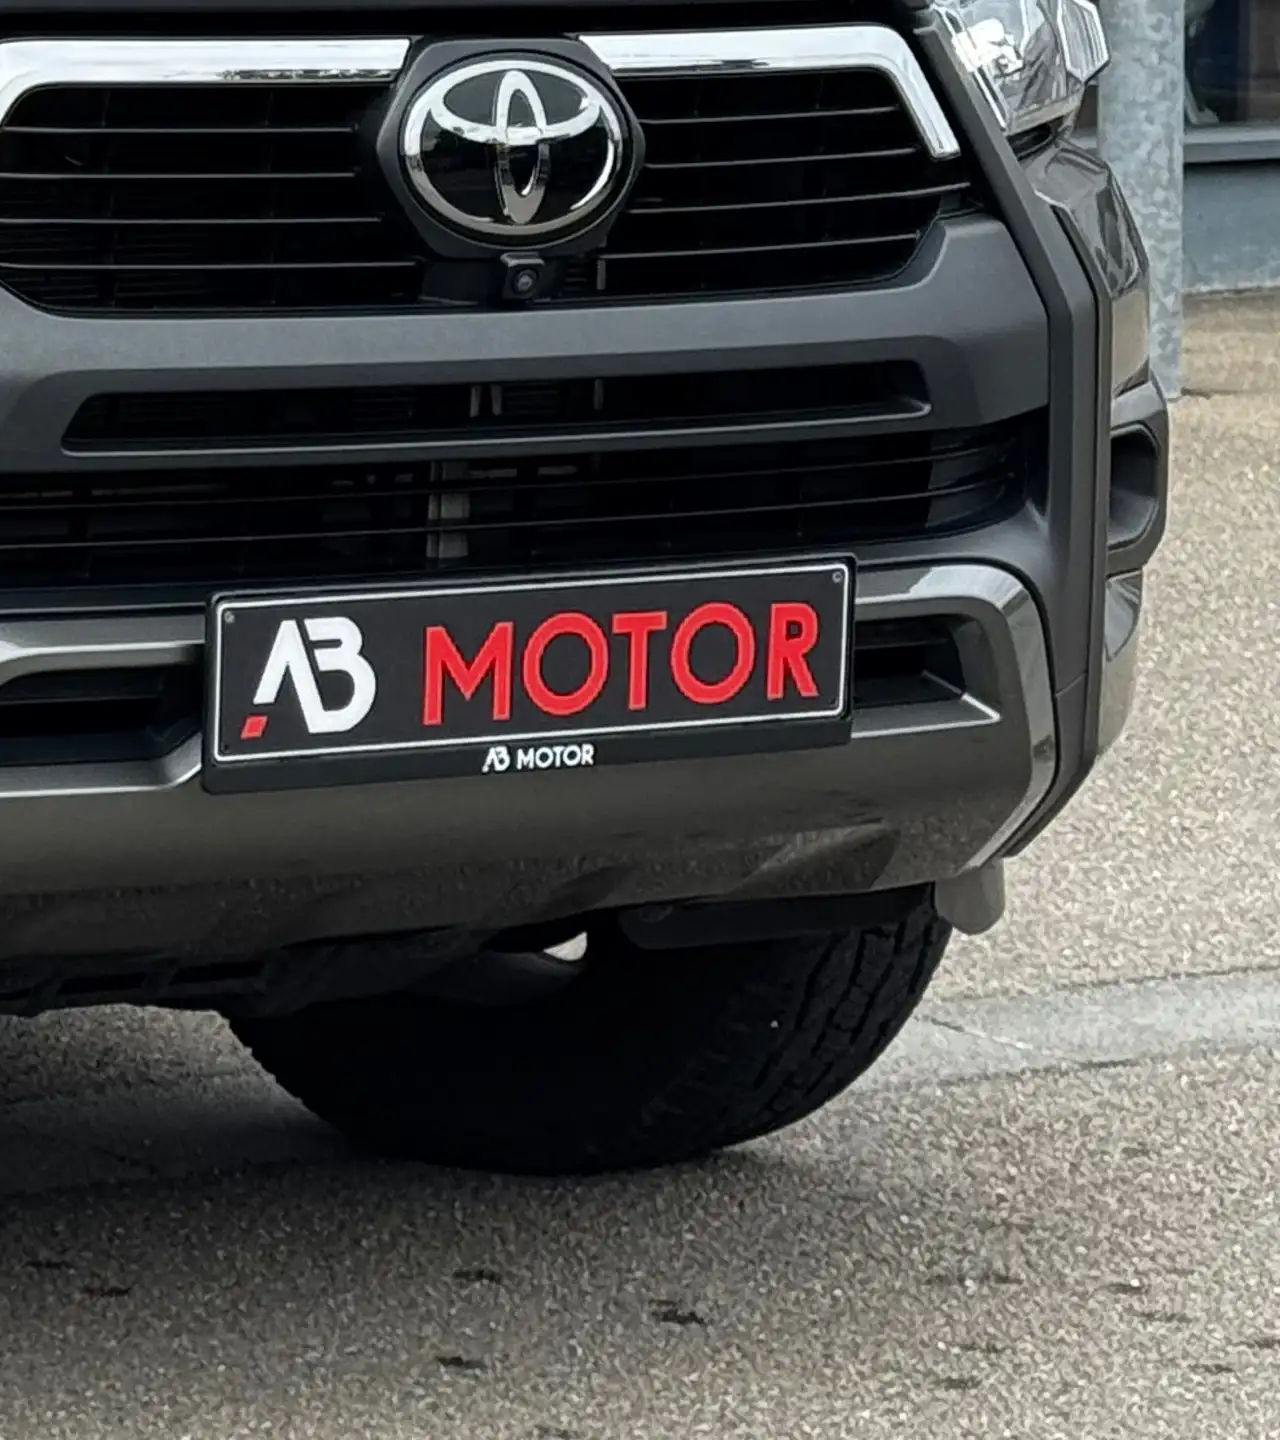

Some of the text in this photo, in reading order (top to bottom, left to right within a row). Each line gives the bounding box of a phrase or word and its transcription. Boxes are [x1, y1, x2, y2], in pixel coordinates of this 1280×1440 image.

[239, 602, 820, 739] AB MOTOR
[481, 743, 595, 773] AB MOTOR
